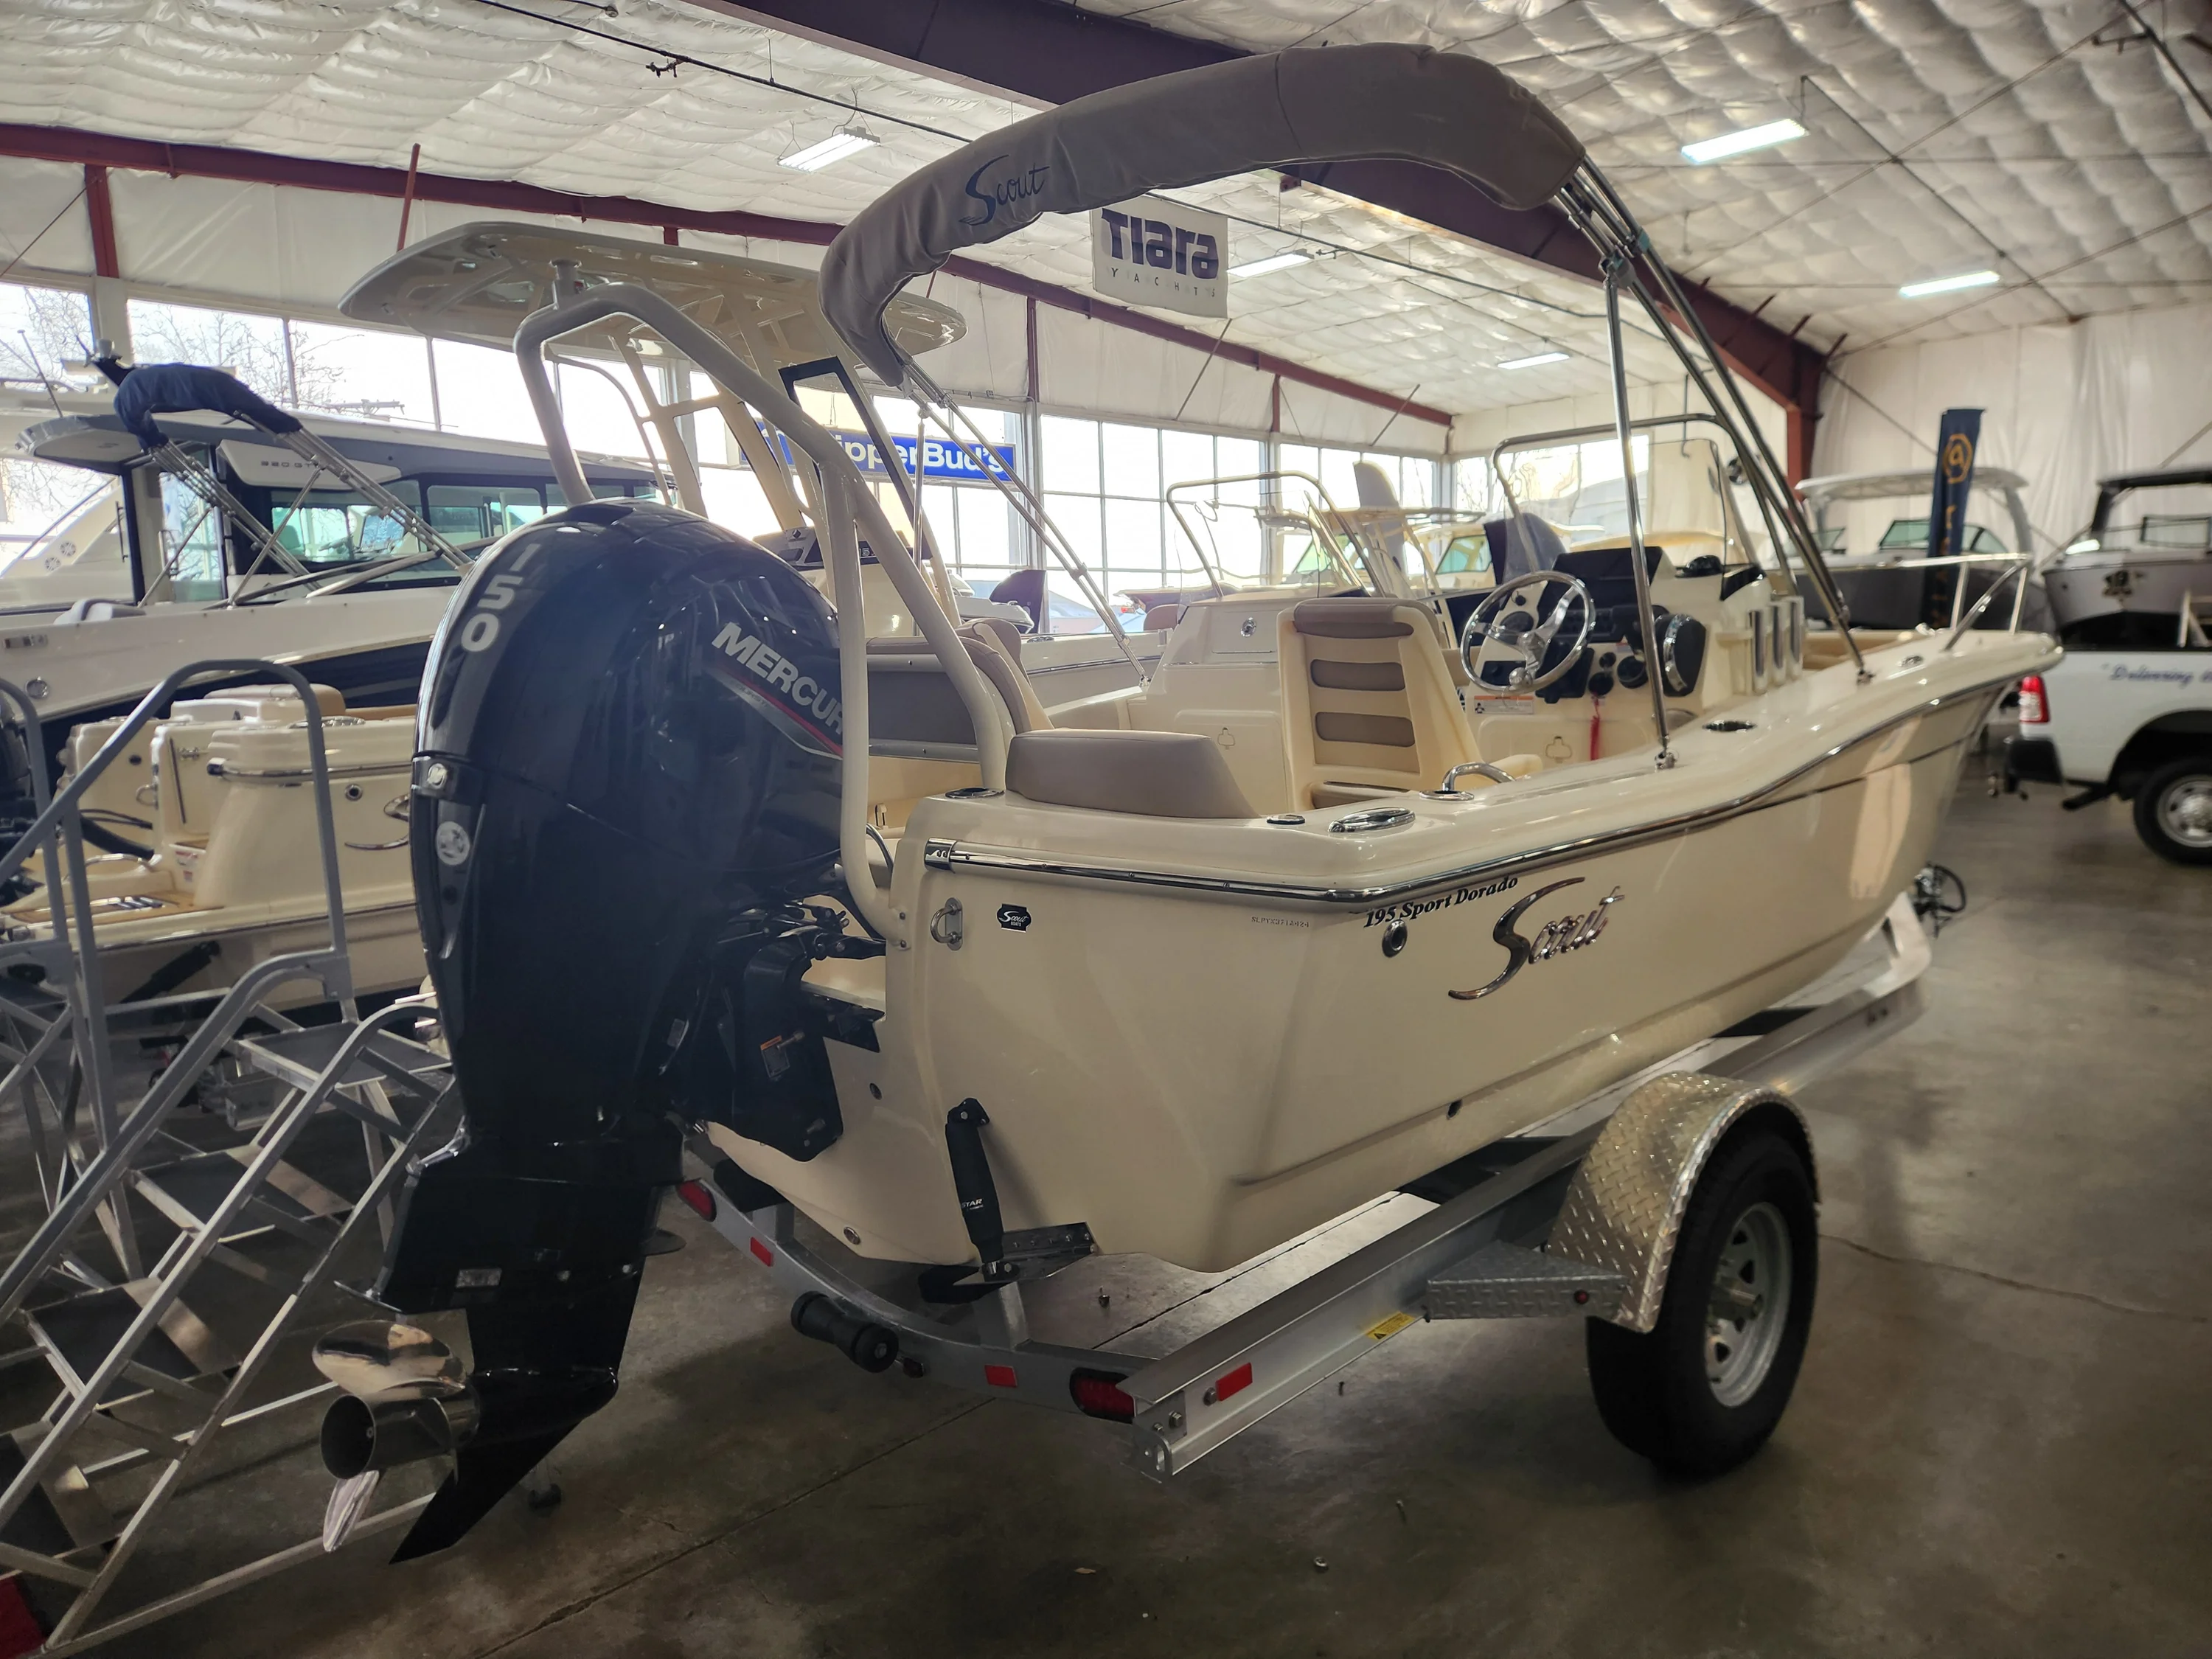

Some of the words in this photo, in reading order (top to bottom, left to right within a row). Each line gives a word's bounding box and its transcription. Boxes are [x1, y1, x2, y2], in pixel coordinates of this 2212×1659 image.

[959, 154, 1049, 226] Scout
[1111, 267, 1215, 296] YACHTS
[461, 543, 540, 652] 150
[712, 622, 843, 735] MERCUR
[998, 911, 1029, 922] Scout
[1364, 907, 1396, 928] 195
[1399, 894, 1452, 919] Sport
[1453, 875, 1518, 905] Dorado
[1447, 877, 1625, 1001] Scout
